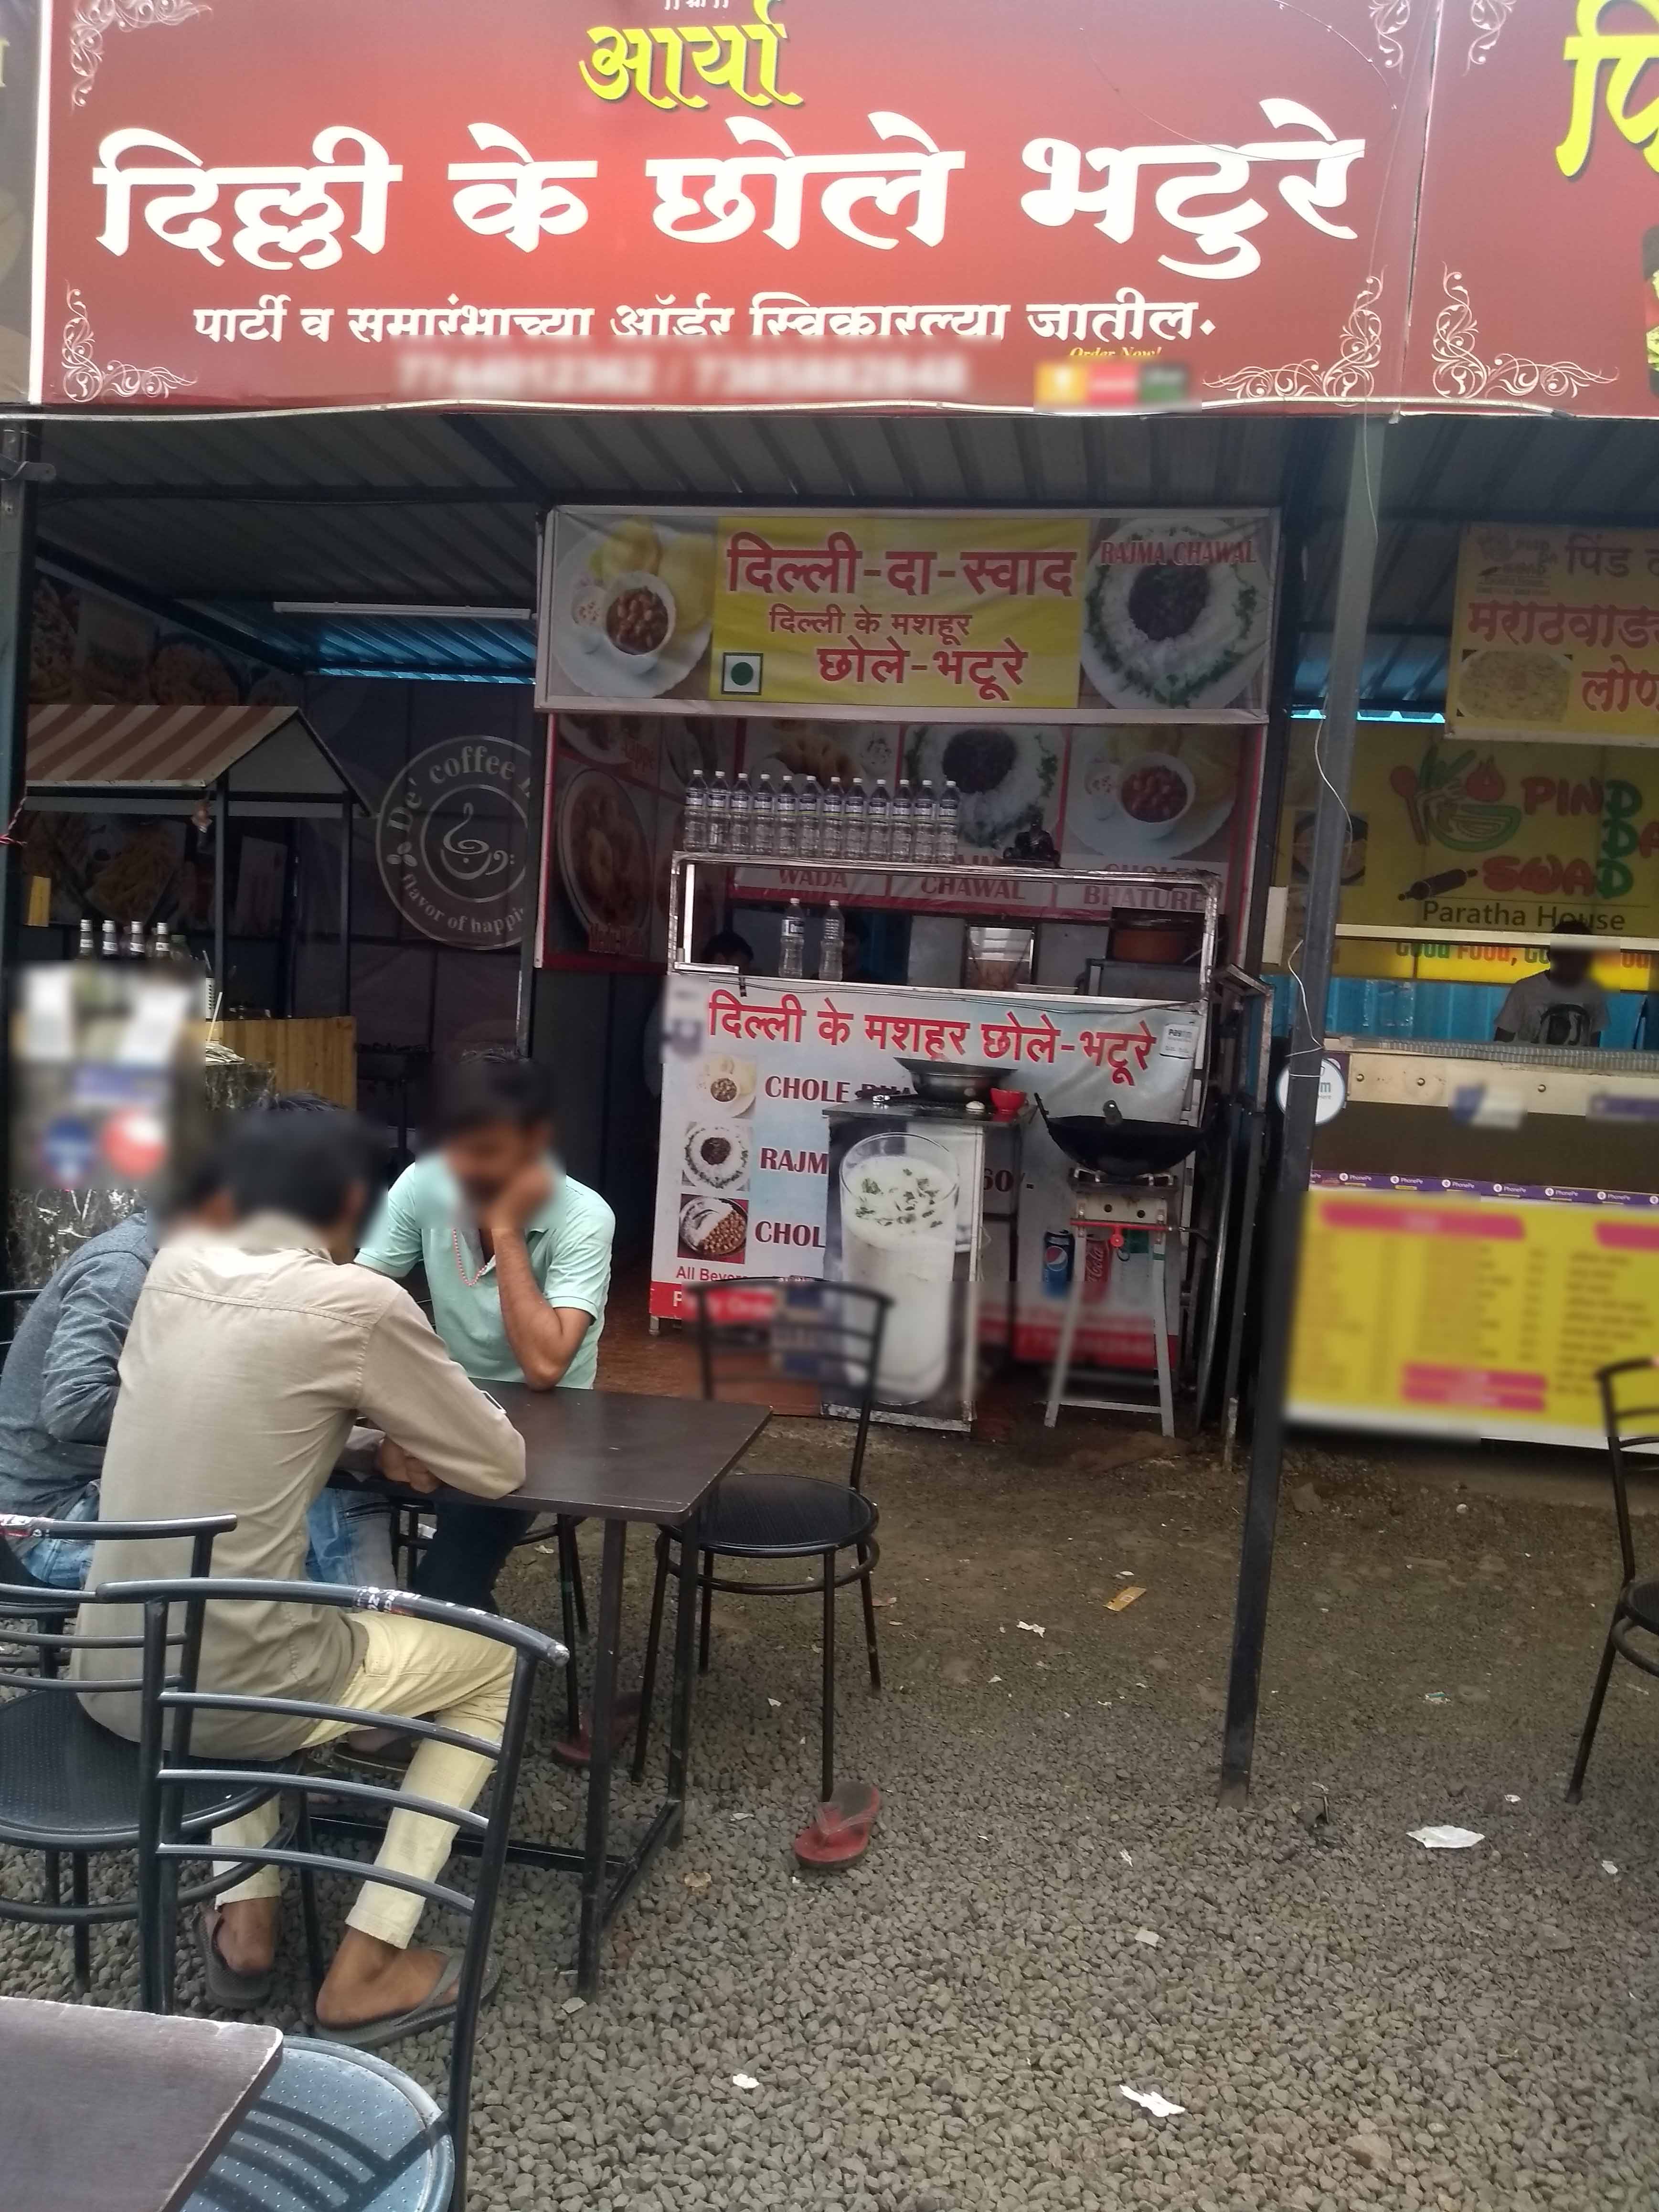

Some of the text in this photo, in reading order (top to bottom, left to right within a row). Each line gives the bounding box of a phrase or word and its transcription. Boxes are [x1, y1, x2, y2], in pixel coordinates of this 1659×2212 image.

[92, 98, 1366, 280] दिल्ली के छोले भटुरे
[194, 295, 290, 342] पार्टी
[301, 307, 334, 342] व
[1100, 540, 1257, 566] RAJMA CHAWAL
[769, 604, 973, 645] दिल्ली के मशहूर
[429, 745, 516, 784] coffee
[778, 869, 847, 888] WADA
[921, 876, 1025, 900] CHAWAL
[447, 914, 467, 933] of
[1423, 901, 1626, 930] Paratha House
[709, 989, 807, 1043] दिल्ली
[817, 997, 854, 1045] के
[765, 1075, 851, 1103] CHOLE
[760, 1147, 830, 1175] RAJM
[755, 1221, 826, 1248] CHOL
[676, 1266, 694, 1281] All
